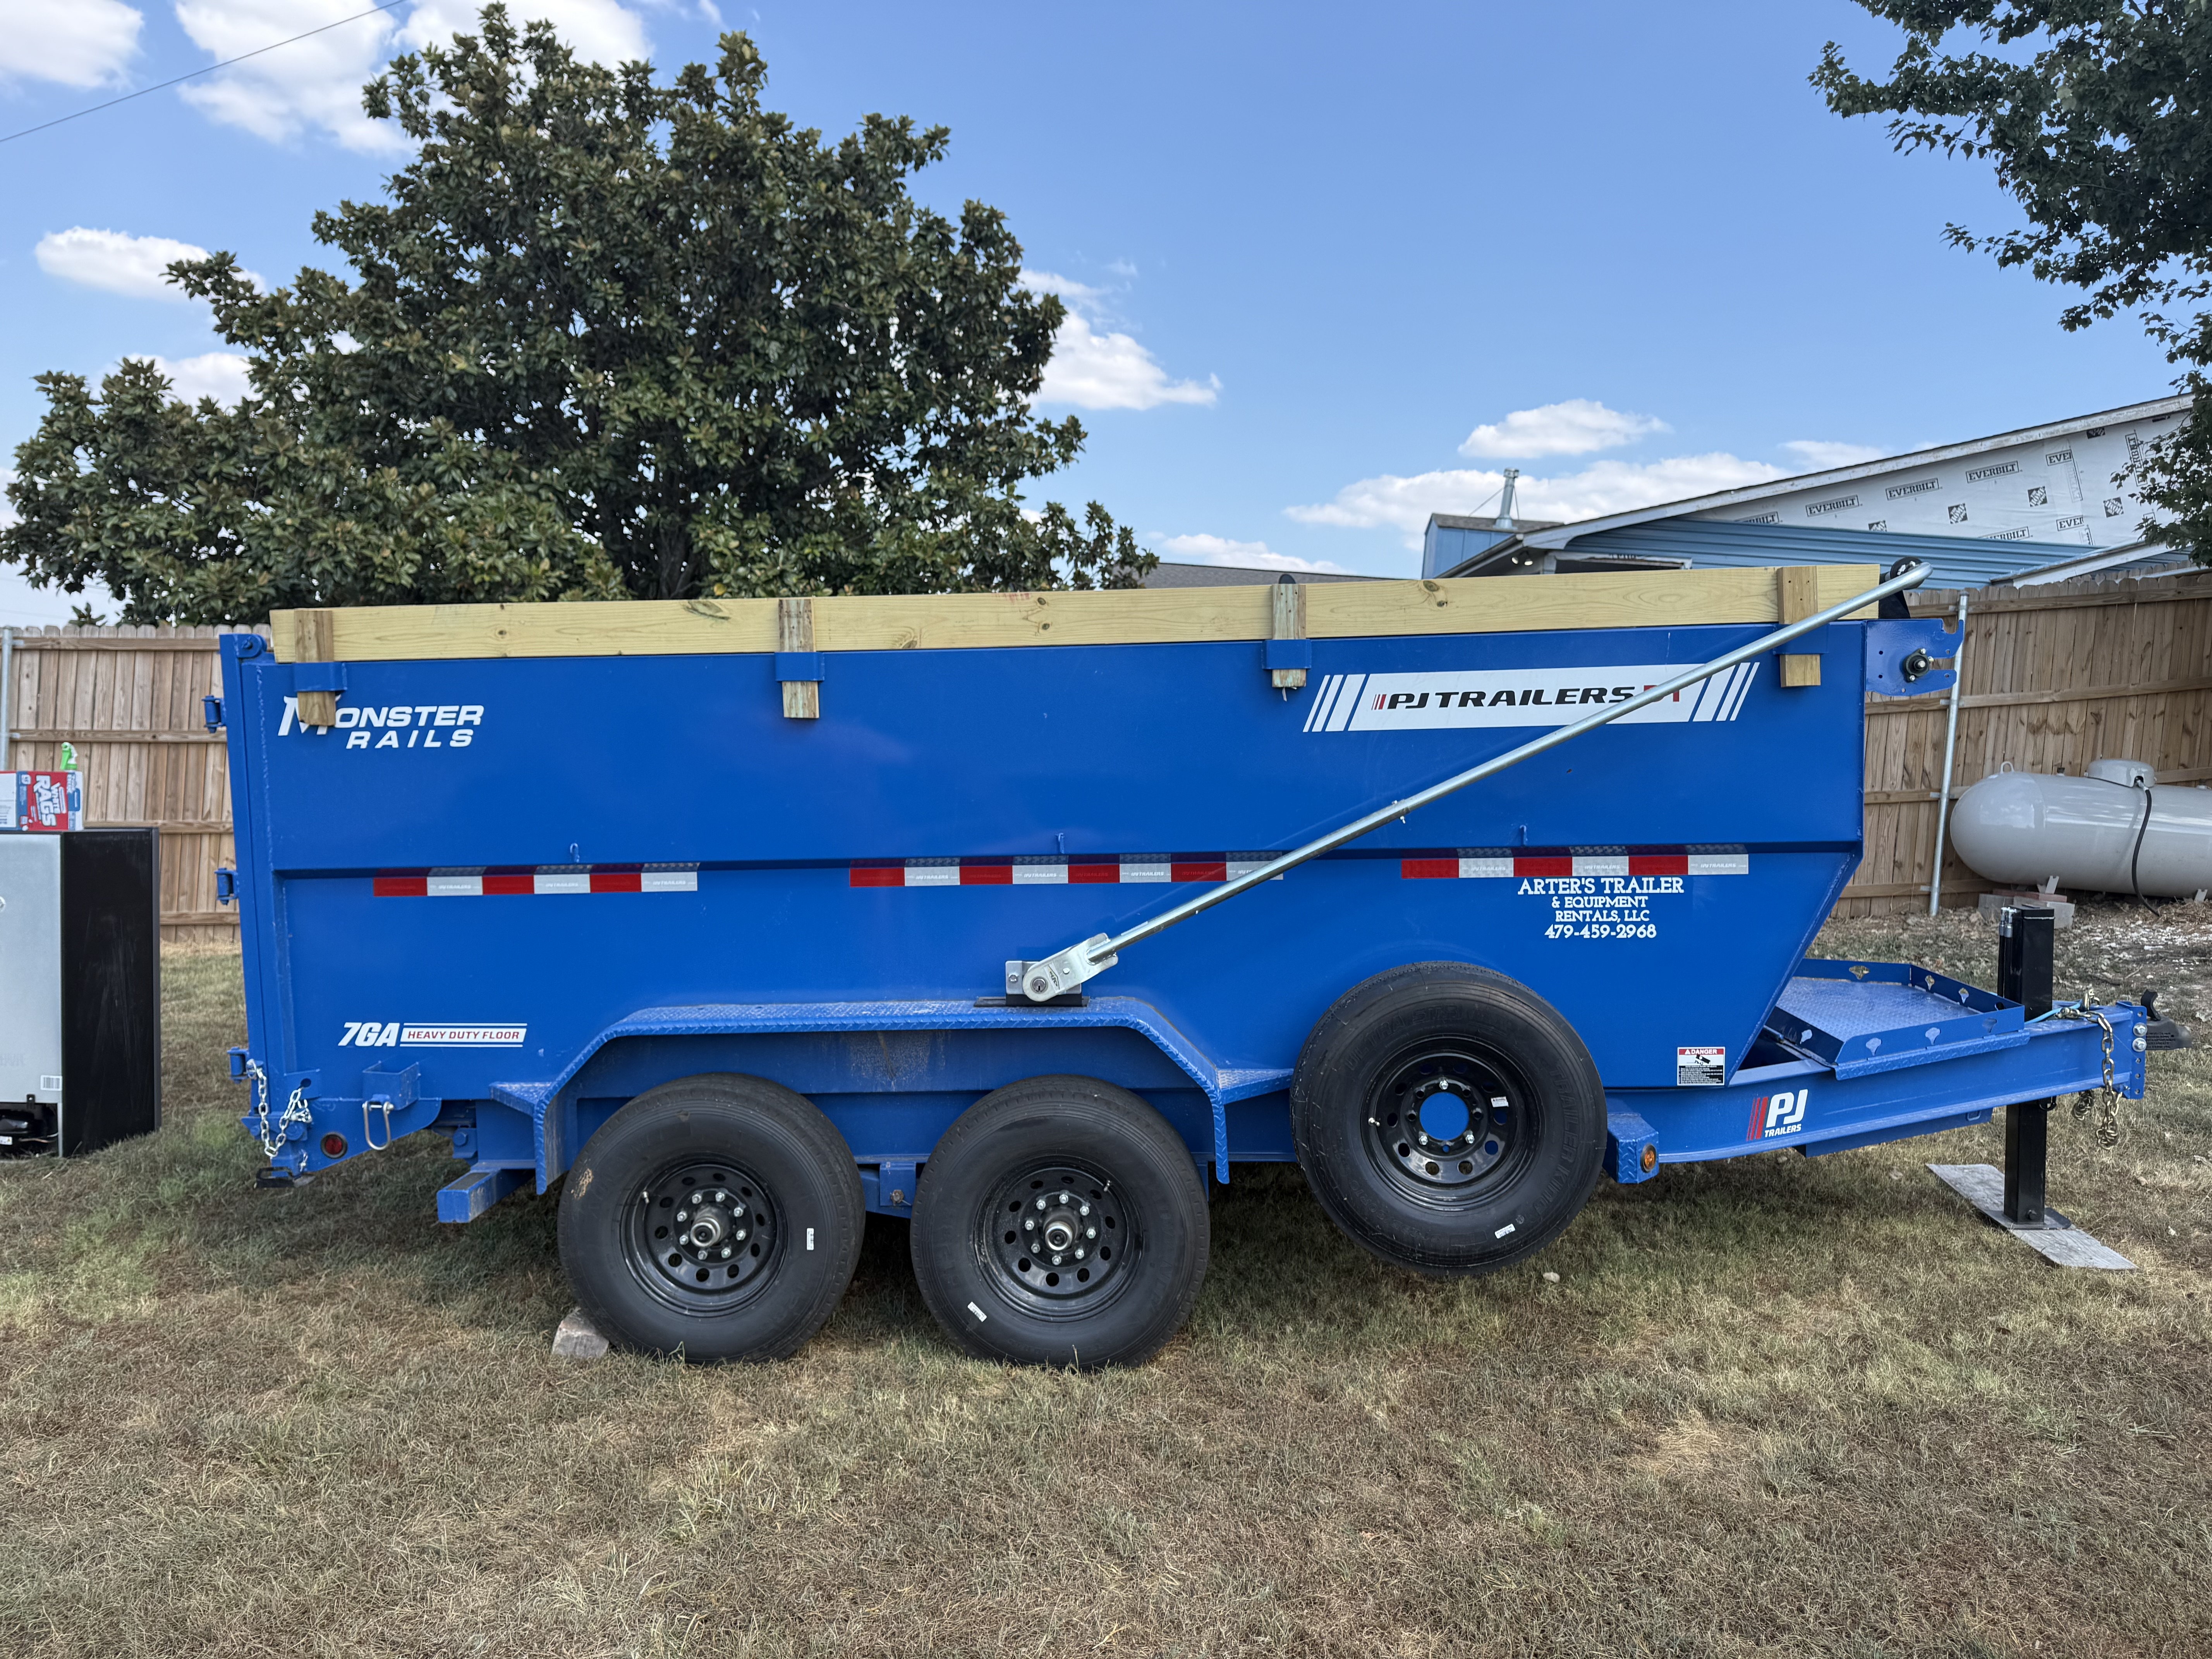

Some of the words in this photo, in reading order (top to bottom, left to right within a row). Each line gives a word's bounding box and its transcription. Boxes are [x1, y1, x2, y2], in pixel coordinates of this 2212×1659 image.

[1968, 464, 2017, 482] EVERBILT
[1888, 481, 1936, 498] EVERBILT
[1808, 497, 1857, 515] EVERBILT
[1388, 693, 1429, 709] PJ
[1435, 686, 1635, 708] TRAILERS
[345, 728, 474, 749] RAILS
[33, 775, 57, 826] RAGS
[1517, 878, 1595, 895] ARTER'S
[1601, 876, 1685, 893] TRAILER
[1551, 896, 1560, 908] &
[1565, 896, 1649, 908] EQUIPMENT
[1555, 909, 1621, 923] RENTALS,
[1624, 909, 1650, 922] LLC
[1544, 924, 1657, 939] 479-459-2968
[338, 1022, 400, 1047] 7GA
[407, 1031, 446, 1039] HEAVY
[449, 1031, 479, 1039] DUTY
[482, 1031, 519, 1039] FLOOR
[1766, 1089, 1808, 1128] PJ
[1765, 1123, 1802, 1138] TRAILERS
